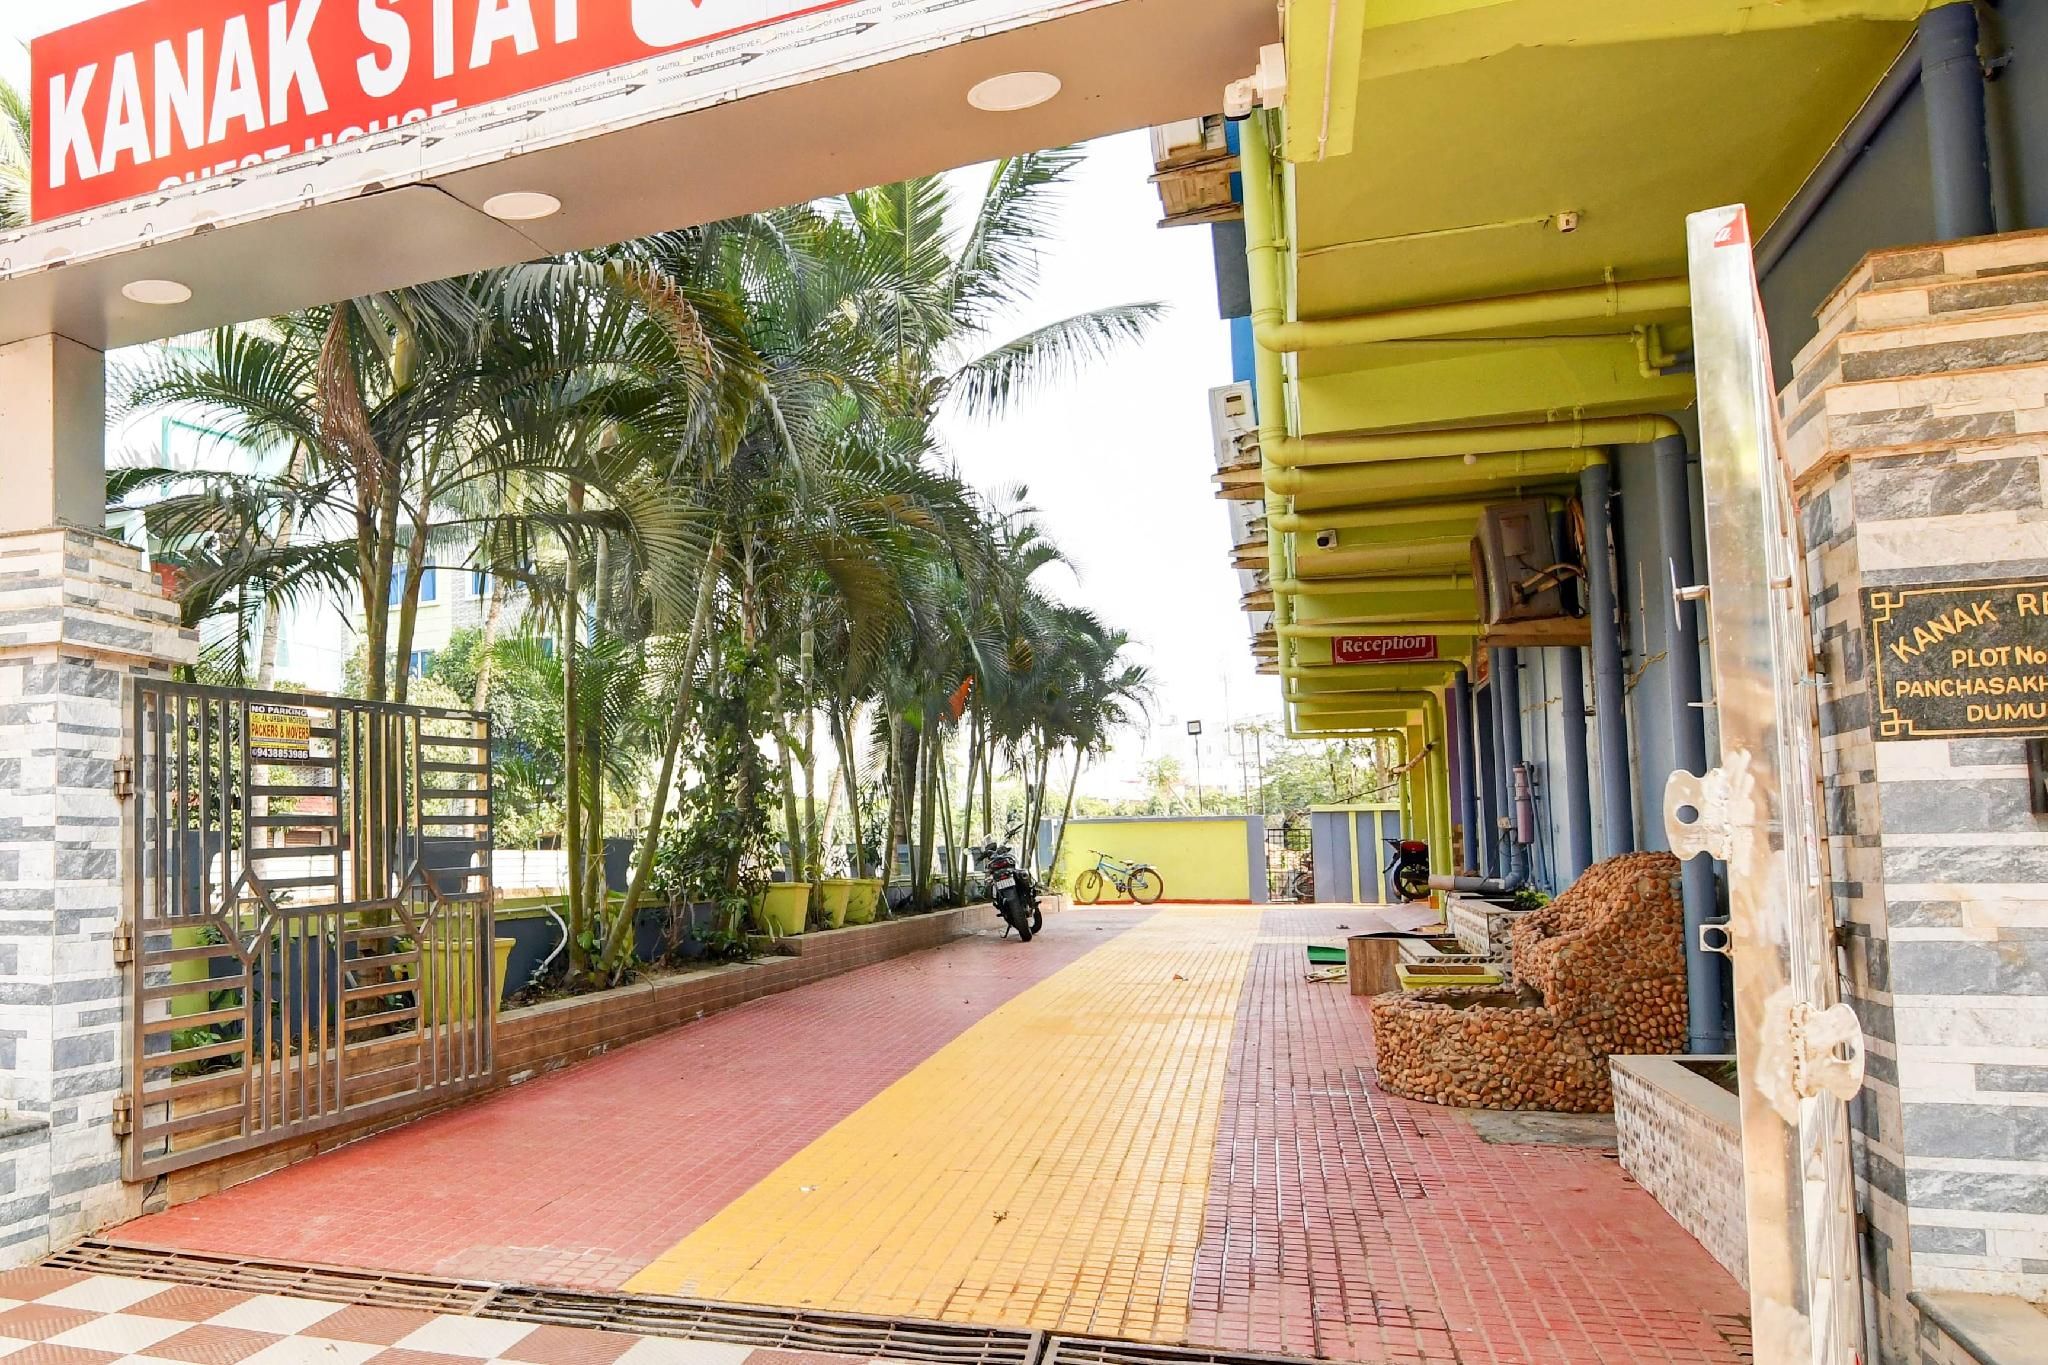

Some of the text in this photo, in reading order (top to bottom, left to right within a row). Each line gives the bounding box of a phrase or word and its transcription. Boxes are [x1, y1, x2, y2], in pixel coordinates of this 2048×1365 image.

[49, 0, 329, 189] KANAK
[1890, 600, 1998, 664] KANAK
[1342, 636, 1426, 655] Reception
[1951, 646, 2011, 669] PLOT
[251, 705, 309, 717] NO PARKING
[251, 723, 279, 738] PACKERS
[280, 726, 285, 738] &
[286, 727, 310, 740] MOVERS
